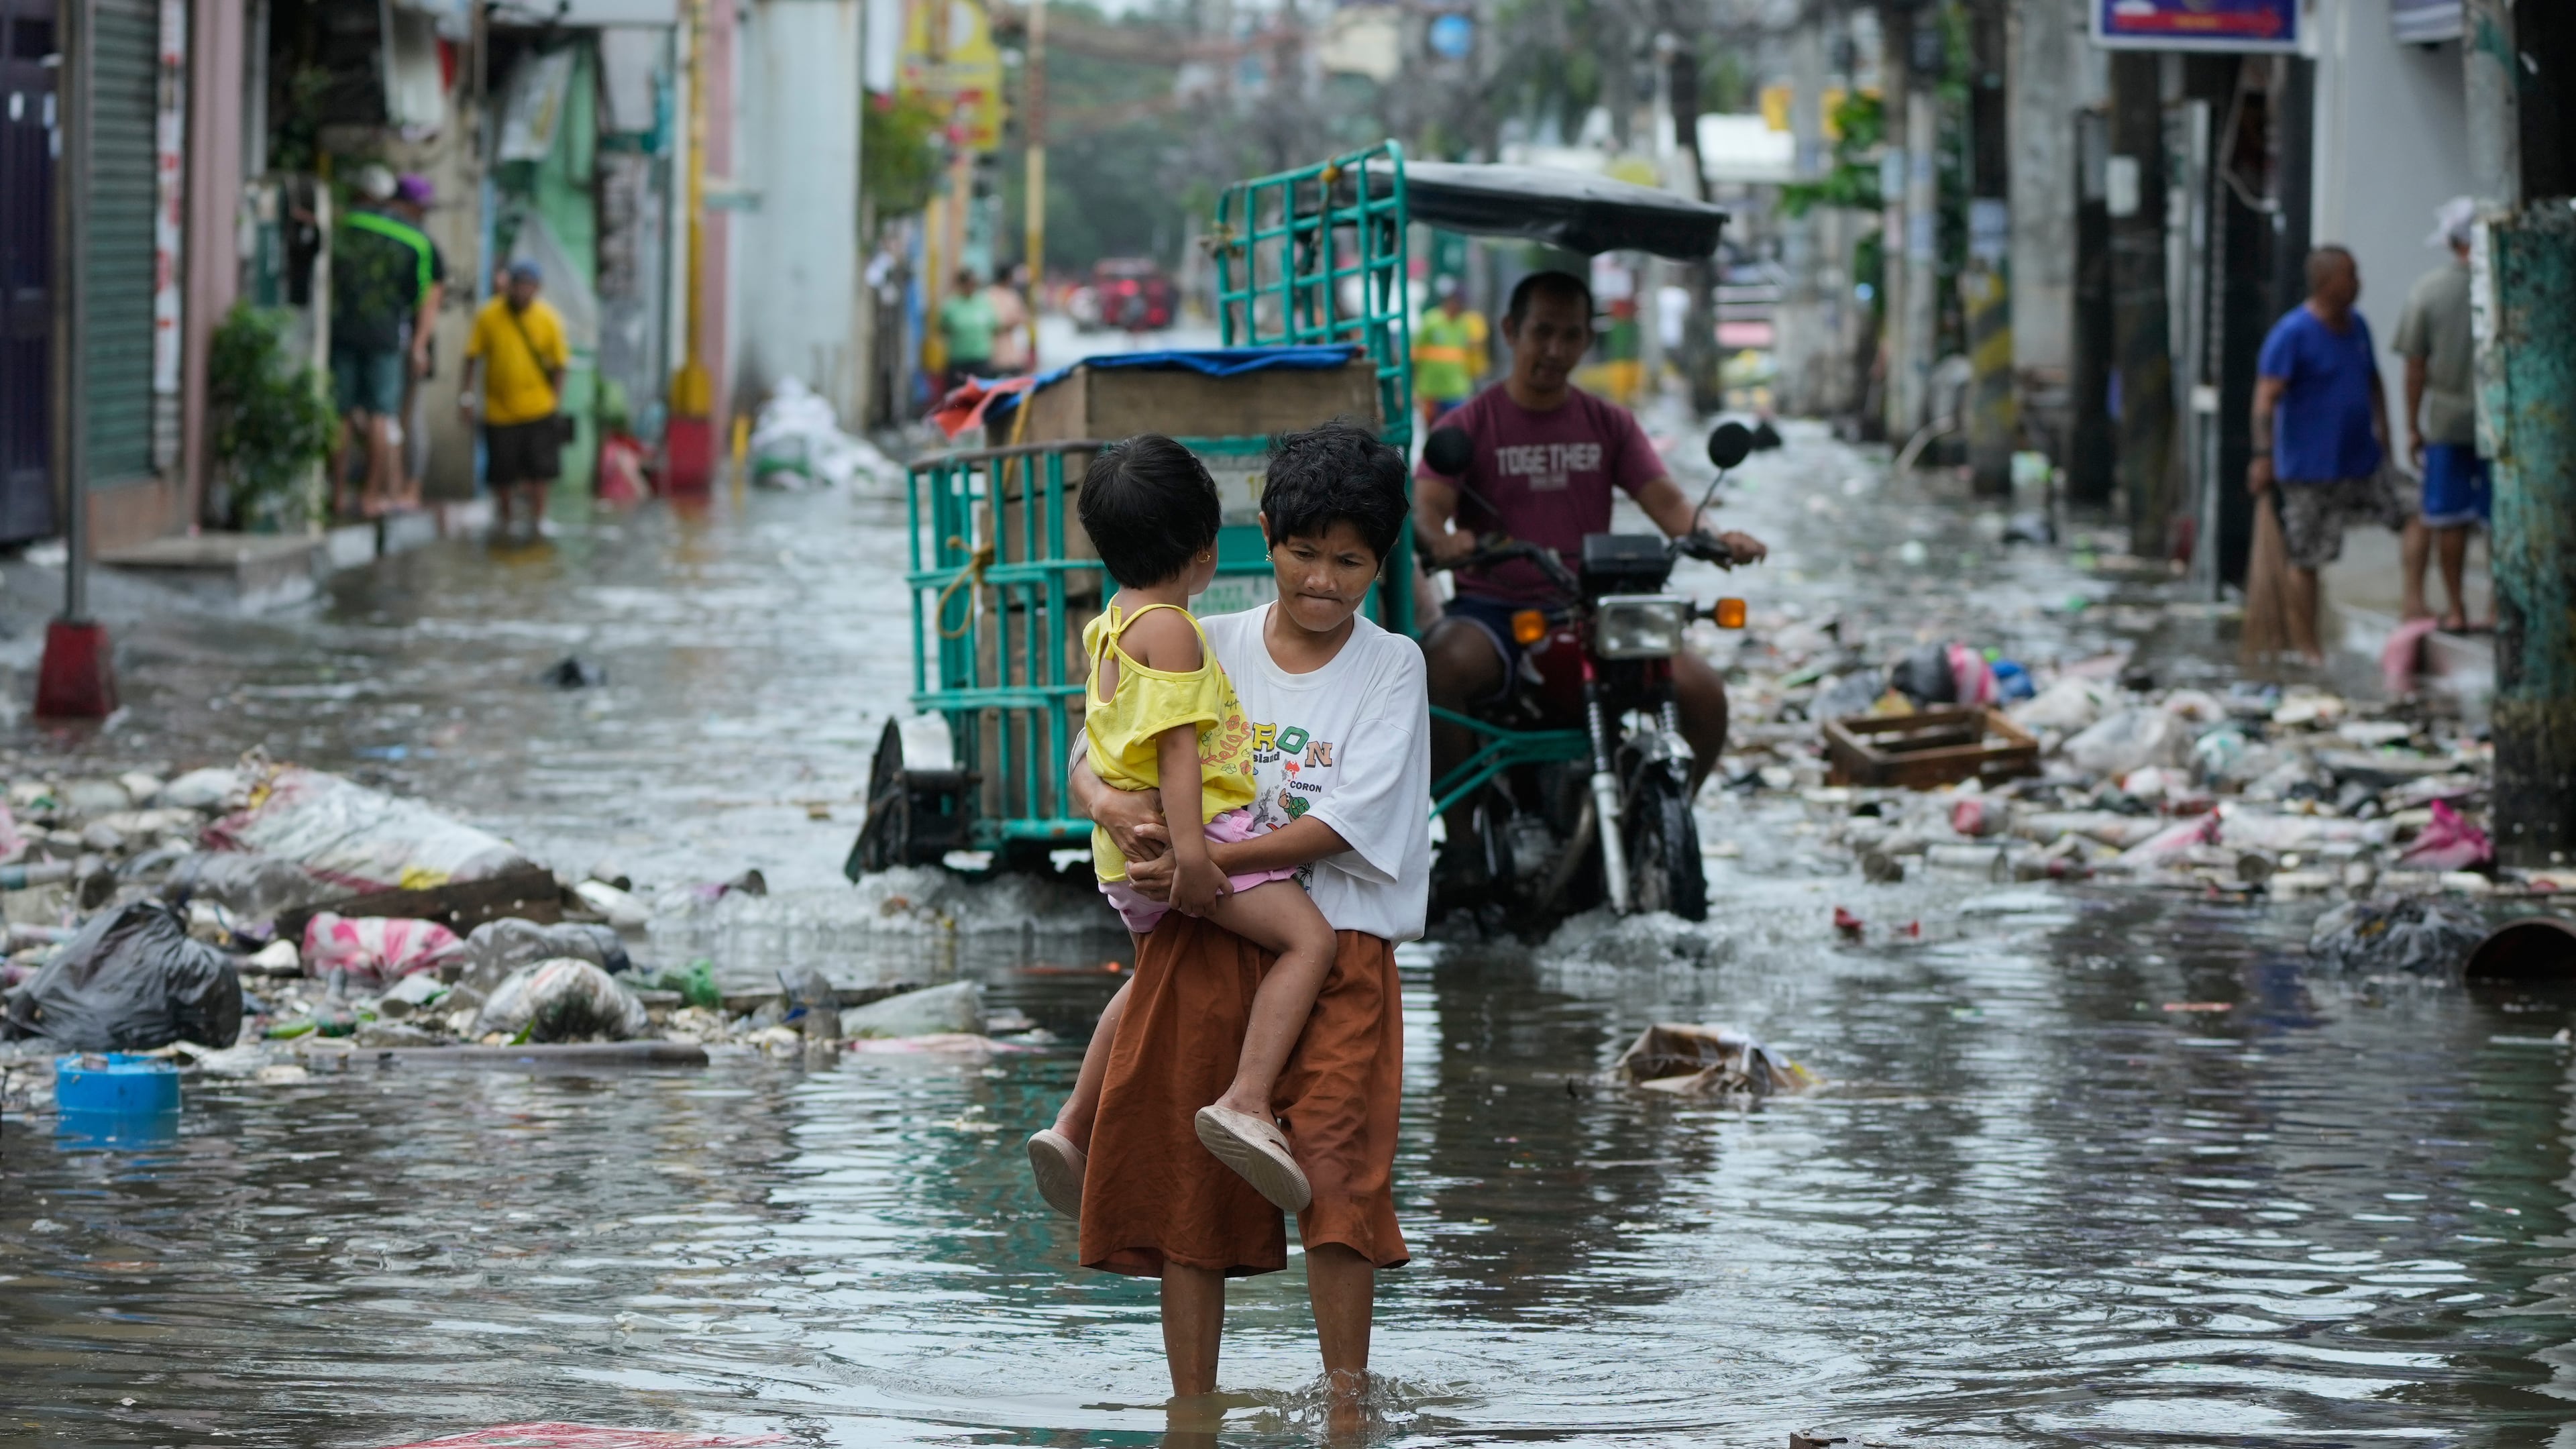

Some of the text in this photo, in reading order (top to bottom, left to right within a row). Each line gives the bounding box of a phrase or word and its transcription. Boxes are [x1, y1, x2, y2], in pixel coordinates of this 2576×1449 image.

[1495, 443, 1601, 476] TOGETHER
[1252, 722, 1333, 767] RON
[1252, 751, 1280, 763] sland
[1289, 780, 1322, 793] CORON
